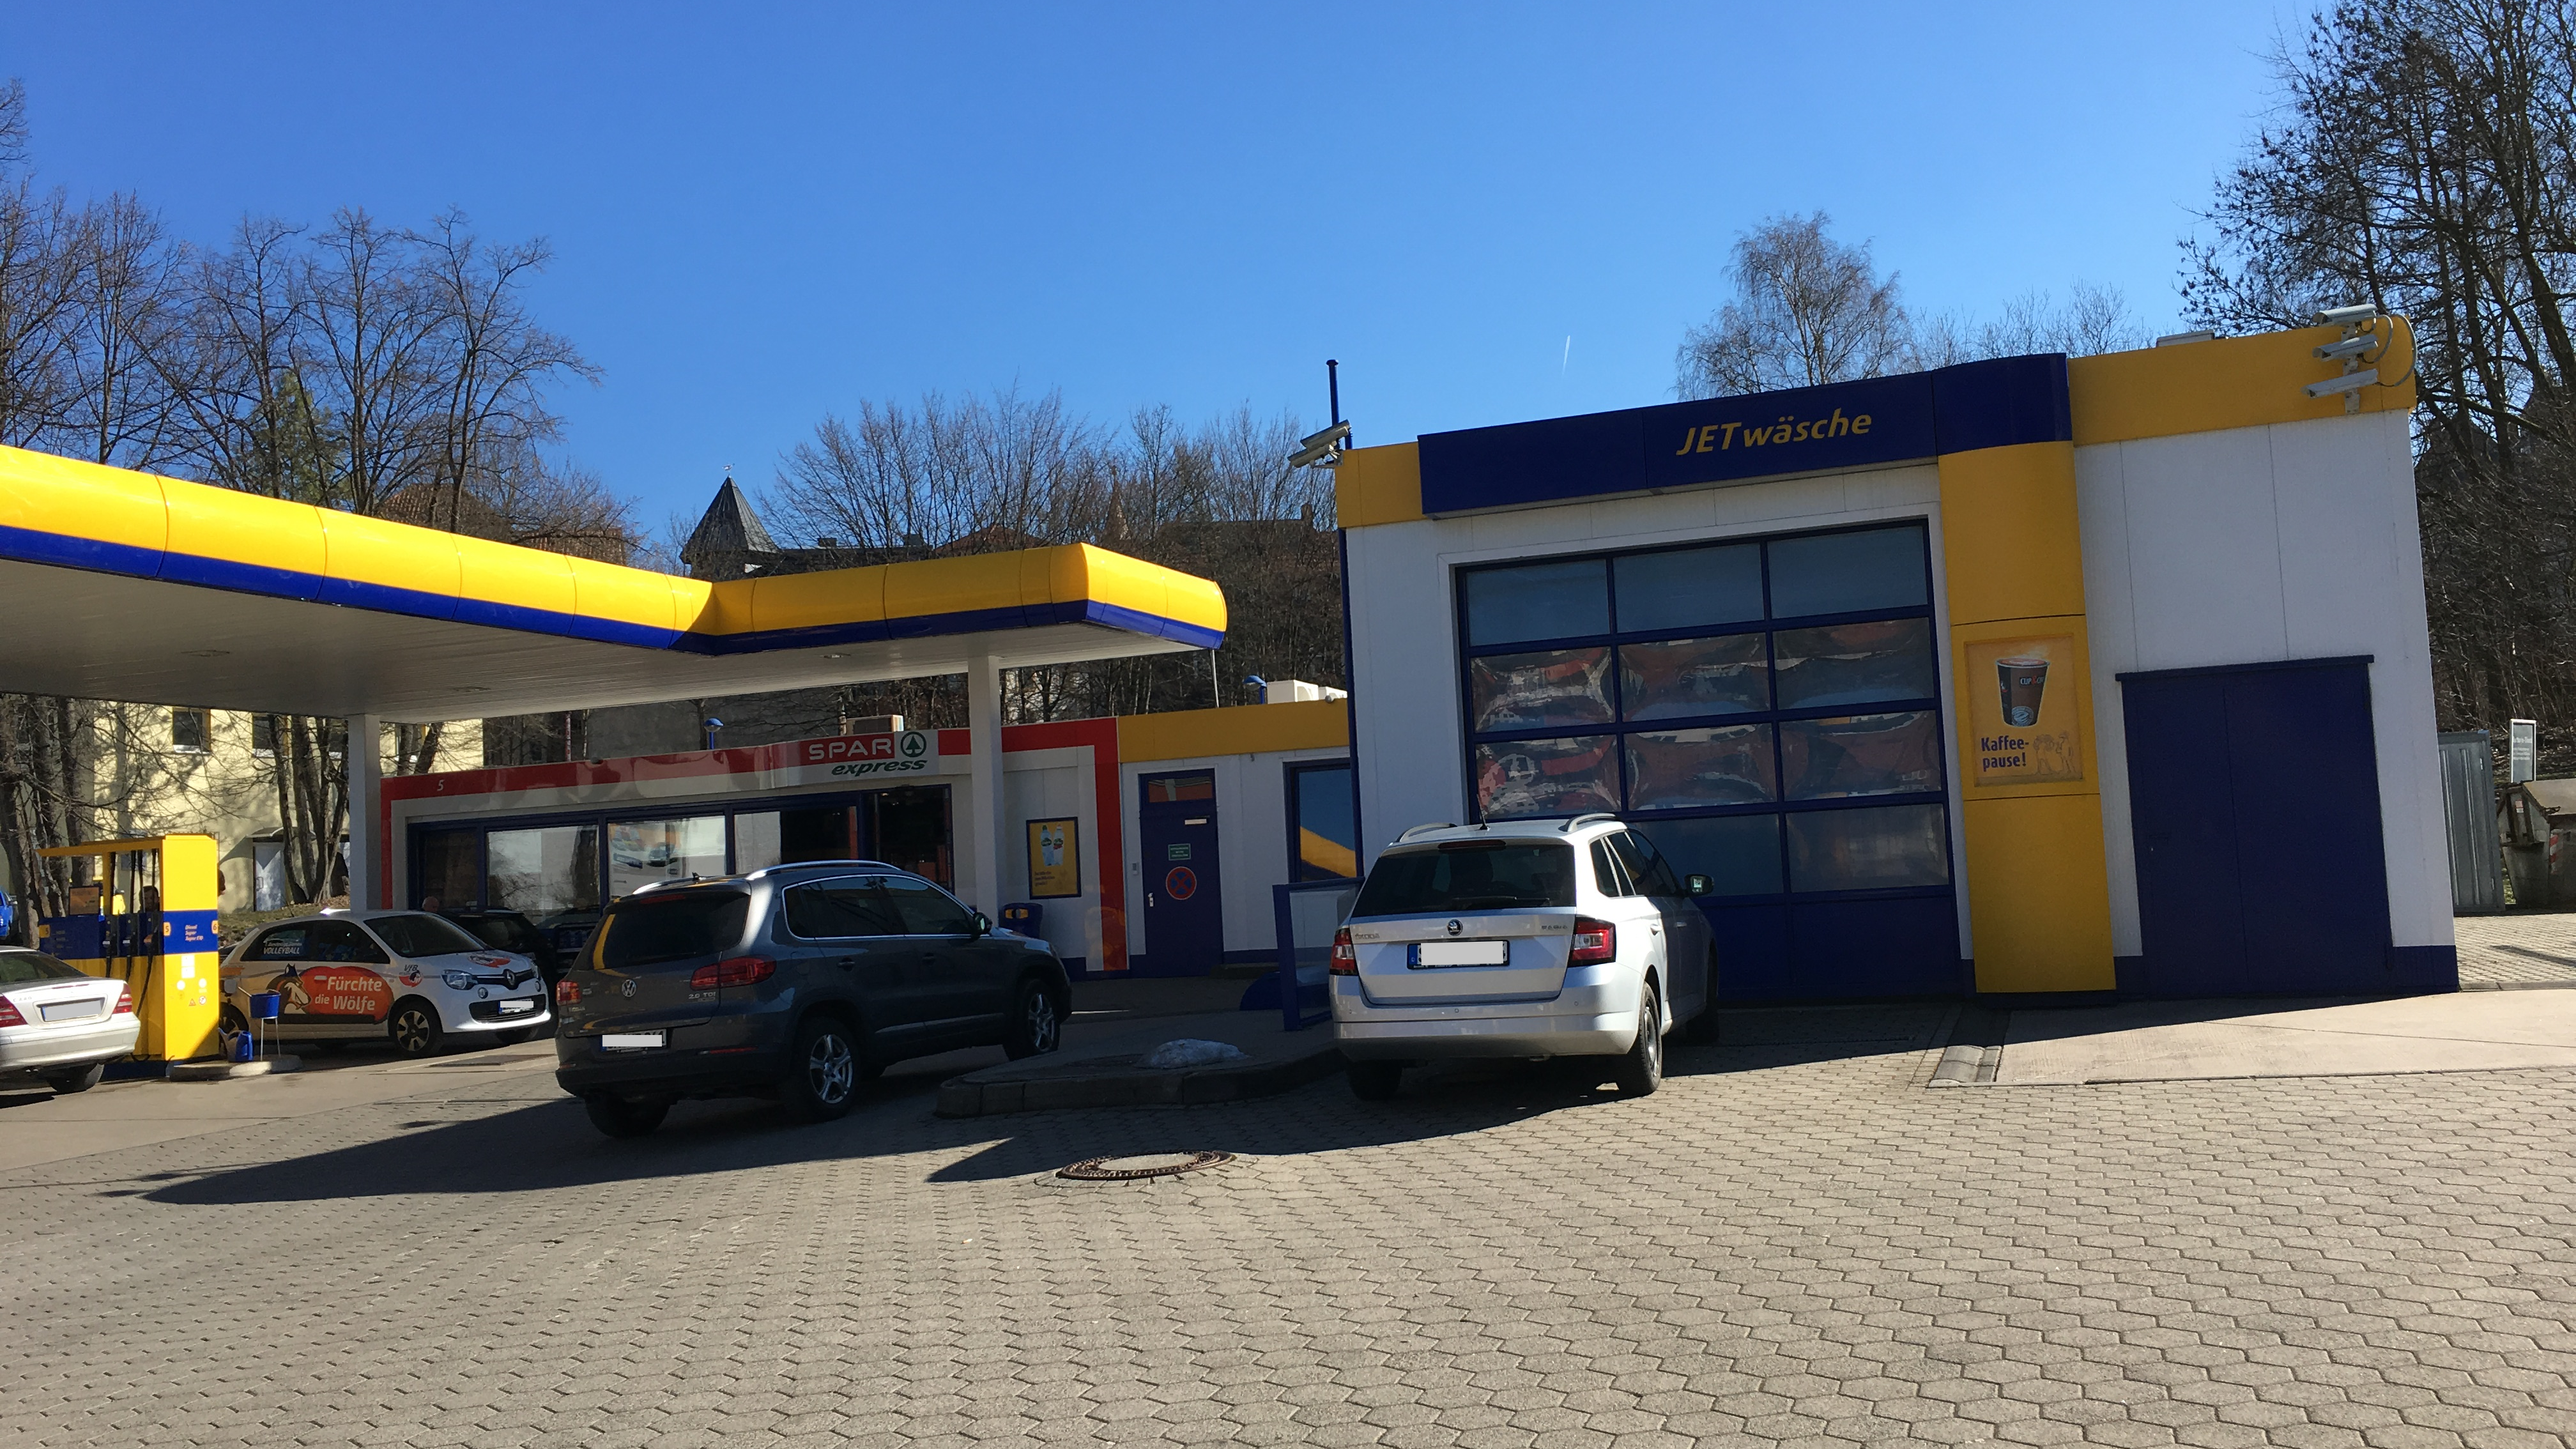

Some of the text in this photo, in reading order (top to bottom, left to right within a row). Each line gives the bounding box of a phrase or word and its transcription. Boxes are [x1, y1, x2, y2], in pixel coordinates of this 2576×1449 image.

[809, 738, 892, 761] SPAR
[1981, 735, 2029, 751] Kaffee-
[831, 758, 928, 778] express
[1982, 752, 2027, 772] pause!
[437, 779, 444, 791] 5
[404, 964, 418, 972] VfB
[327, 976, 382, 992] Fürchte
[314, 994, 330, 1004] die
[333, 995, 376, 1014] Wölfe
